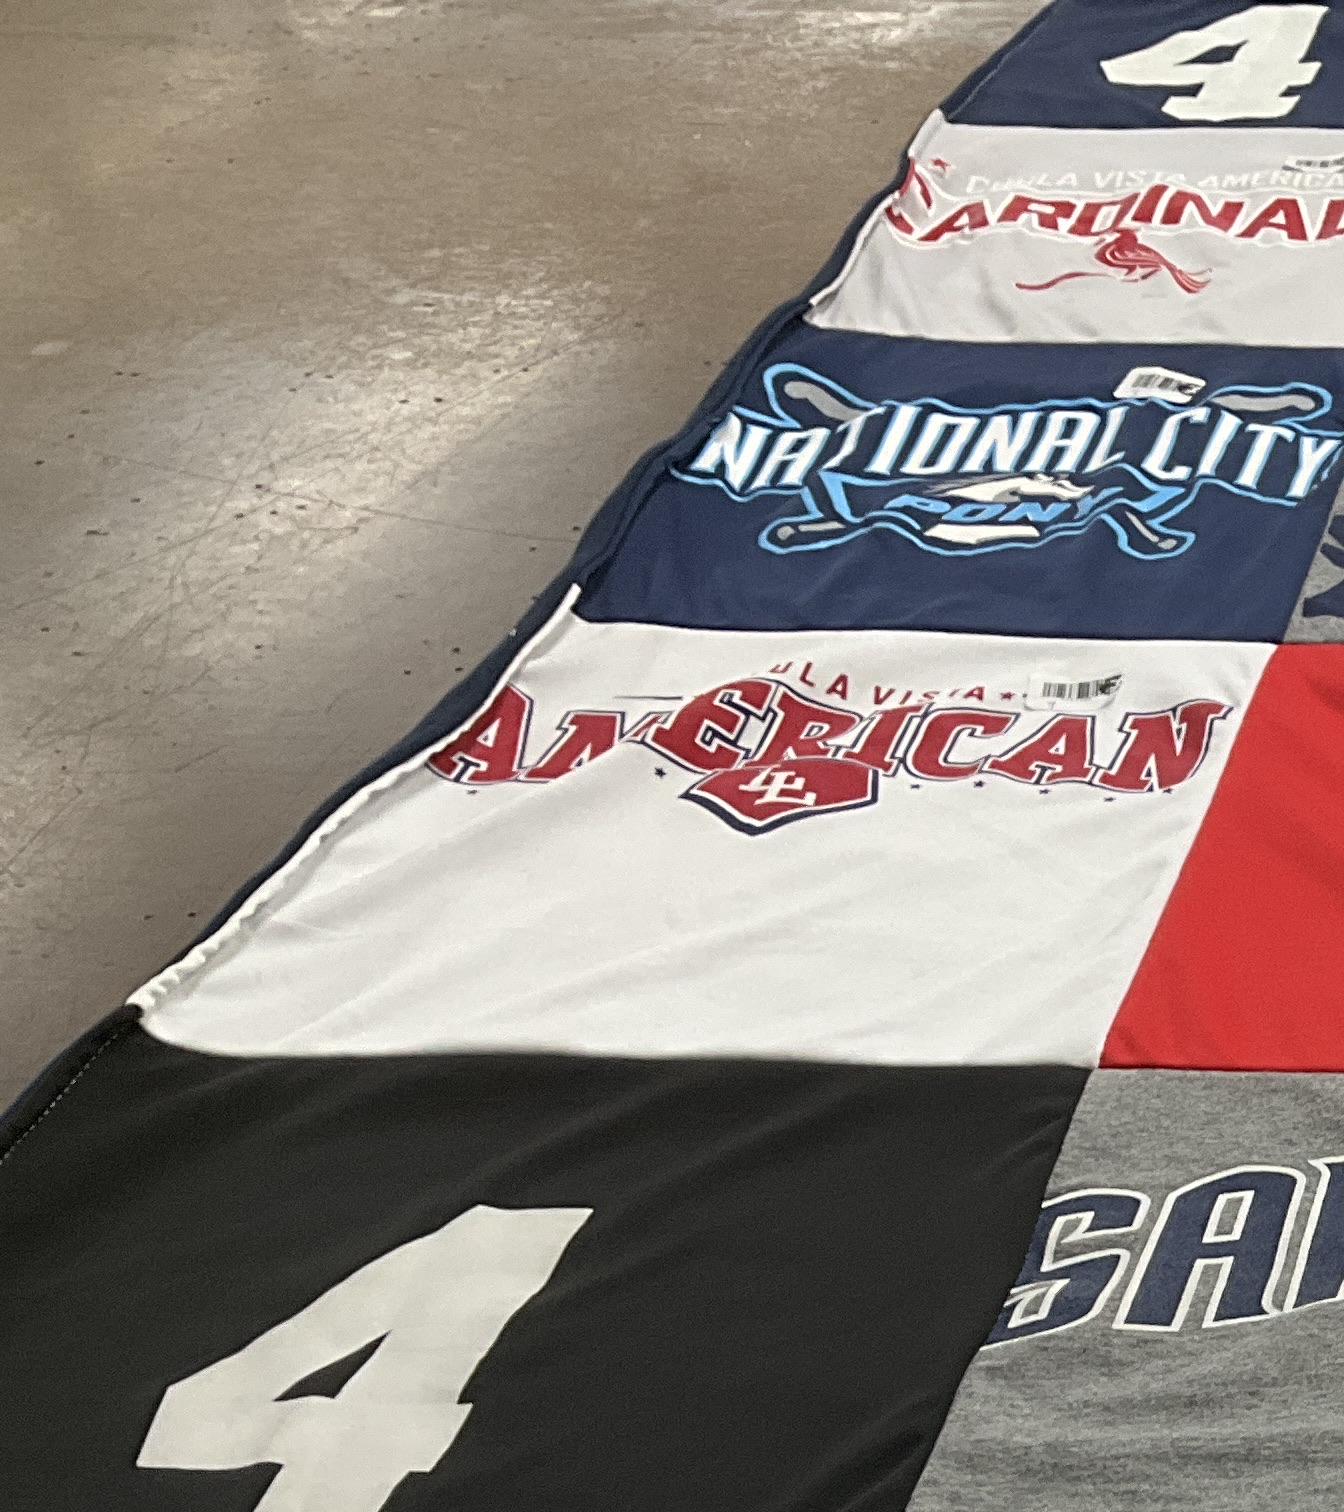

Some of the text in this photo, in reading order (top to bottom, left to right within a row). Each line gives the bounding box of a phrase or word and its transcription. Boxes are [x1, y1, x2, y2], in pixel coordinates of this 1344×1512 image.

[1101, 4, 1329, 121] 4
[699, 403, 1342, 500] NATIONAL CITY
[423, 676, 1234, 794] AMERICAN
